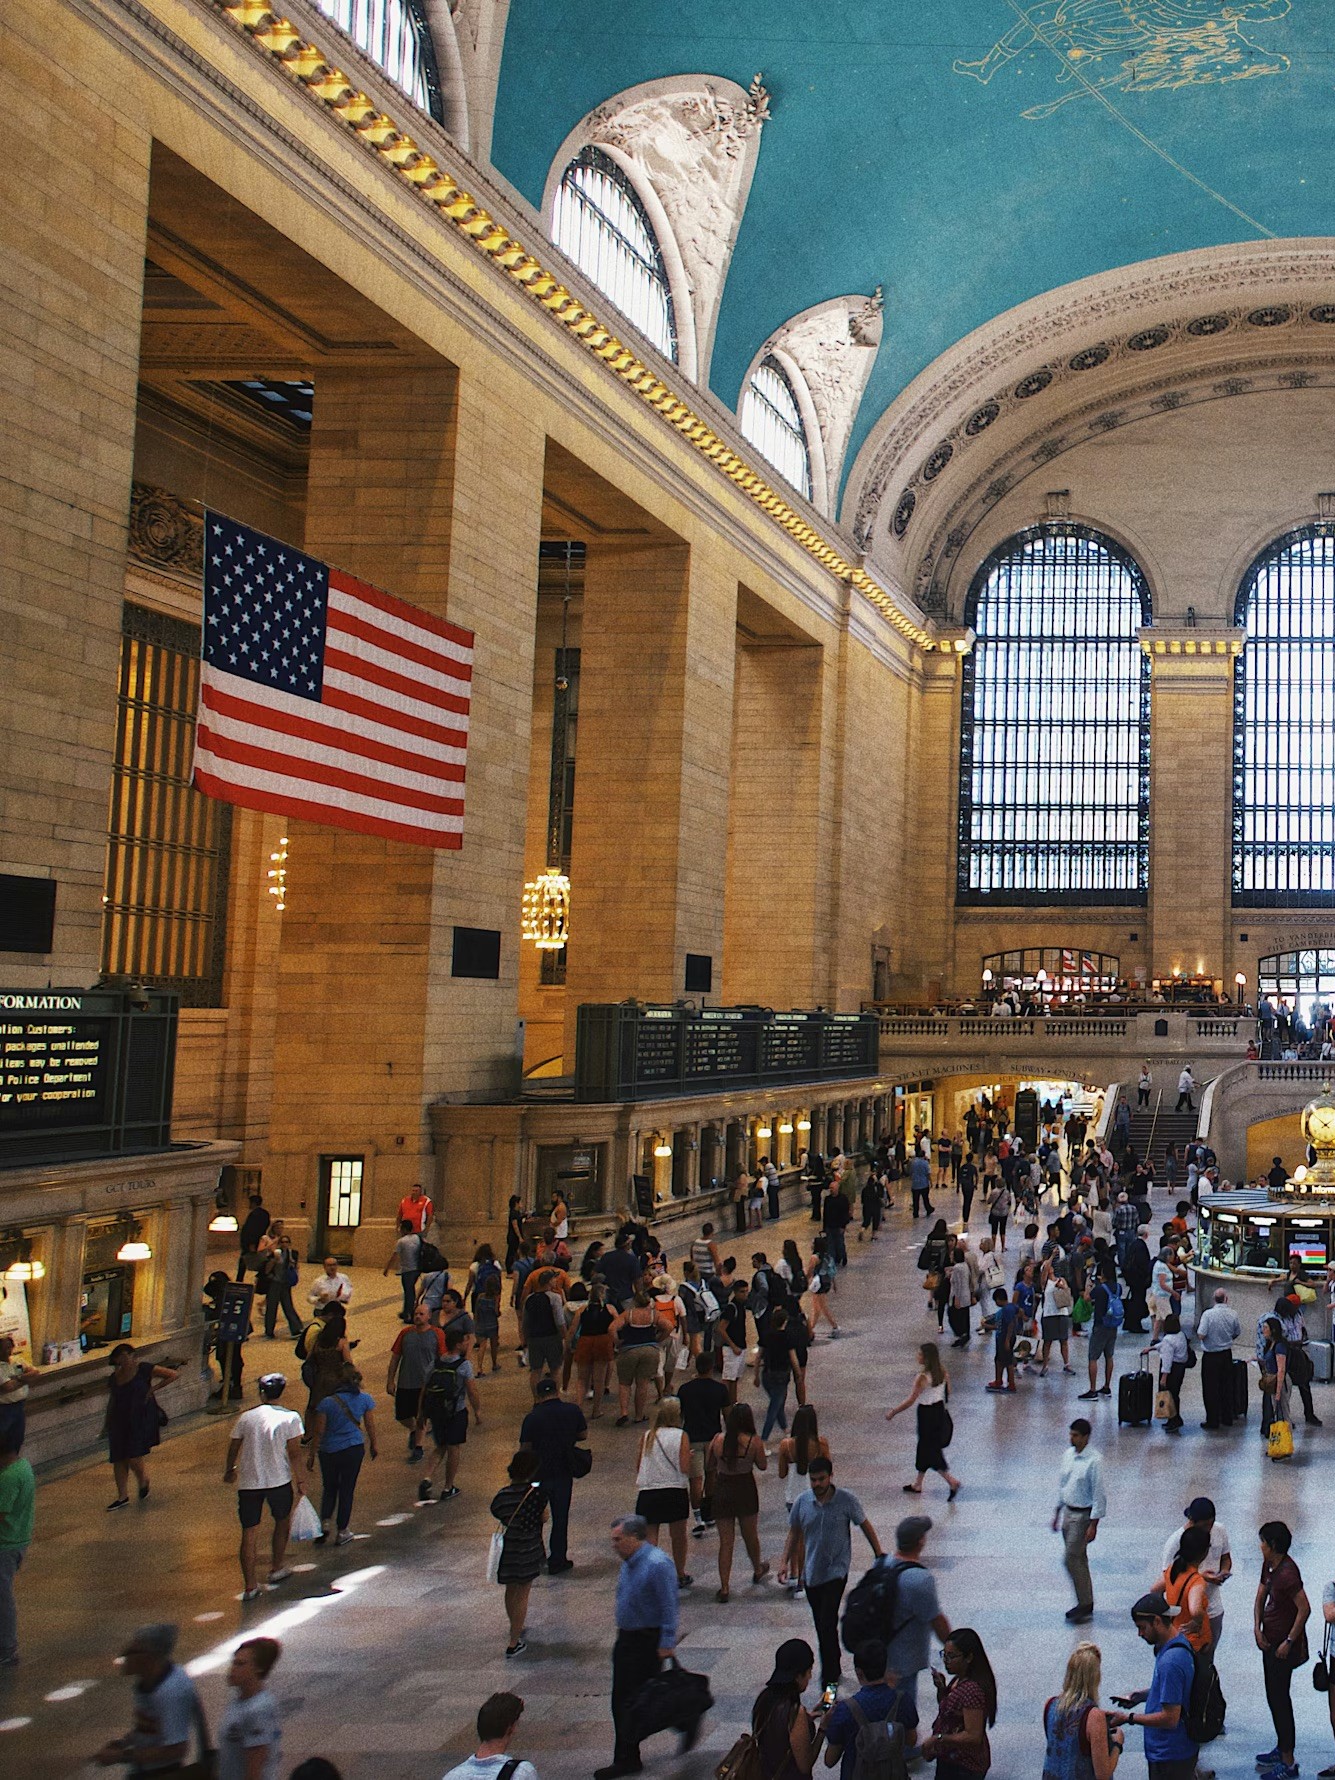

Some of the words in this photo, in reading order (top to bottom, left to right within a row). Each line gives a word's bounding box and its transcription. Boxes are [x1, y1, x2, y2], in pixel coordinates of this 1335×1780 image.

[1267, 944, 1284, 952] THE
[5, 1042, 47, 1053] packages
[51, 1040, 100, 1050] unattended
[29, 1060, 46, 1069] may
[50, 1057, 61, 1067] be
[65, 1056, 99, 1066] removed
[897, 1068, 930, 1081] TICKET
[932, 1063, 981, 1074] MACHINES
[1011, 1064, 1046, 1073] SUBWAY
[1051, 1068, 1076, 1079] 42ND
[8, 1075, 40, 1085] Police
[44, 1072, 92, 1084] Department
[0, 1094, 13, 1103] or
[16, 1093, 38, 1103] your
[42, 1089, 96, 1101] cooperation
